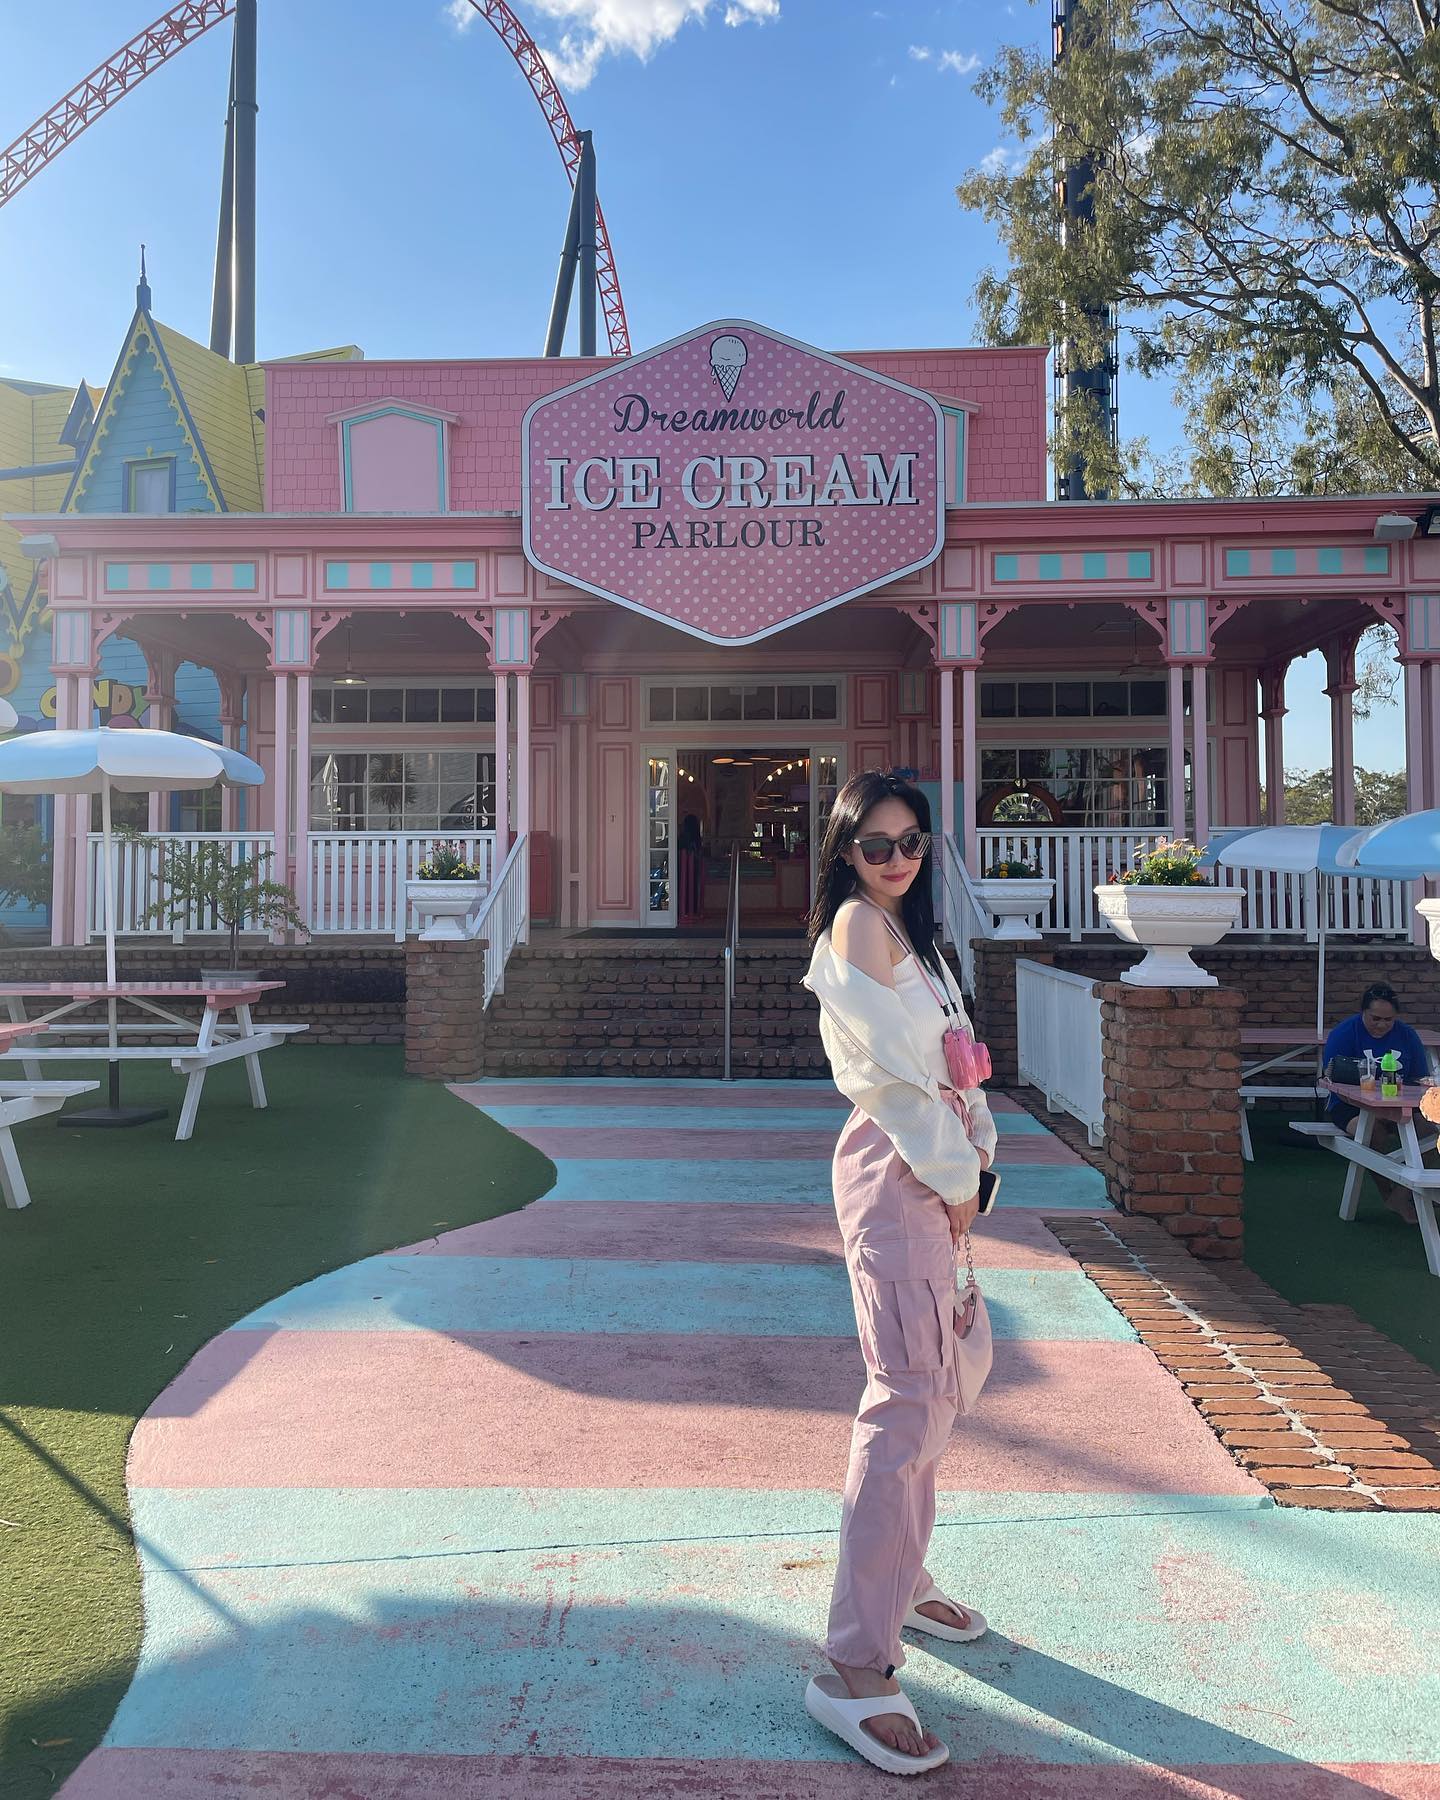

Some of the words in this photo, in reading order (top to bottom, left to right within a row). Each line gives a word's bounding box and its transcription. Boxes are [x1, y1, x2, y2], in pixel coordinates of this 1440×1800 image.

[613, 390, 846, 434] Dreamworld
[544, 456, 662, 512] ICE
[681, 452, 920, 511] CREAM
[631, 519, 826, 549] PARLOUR
[40, 679, 149, 720] CNDY
